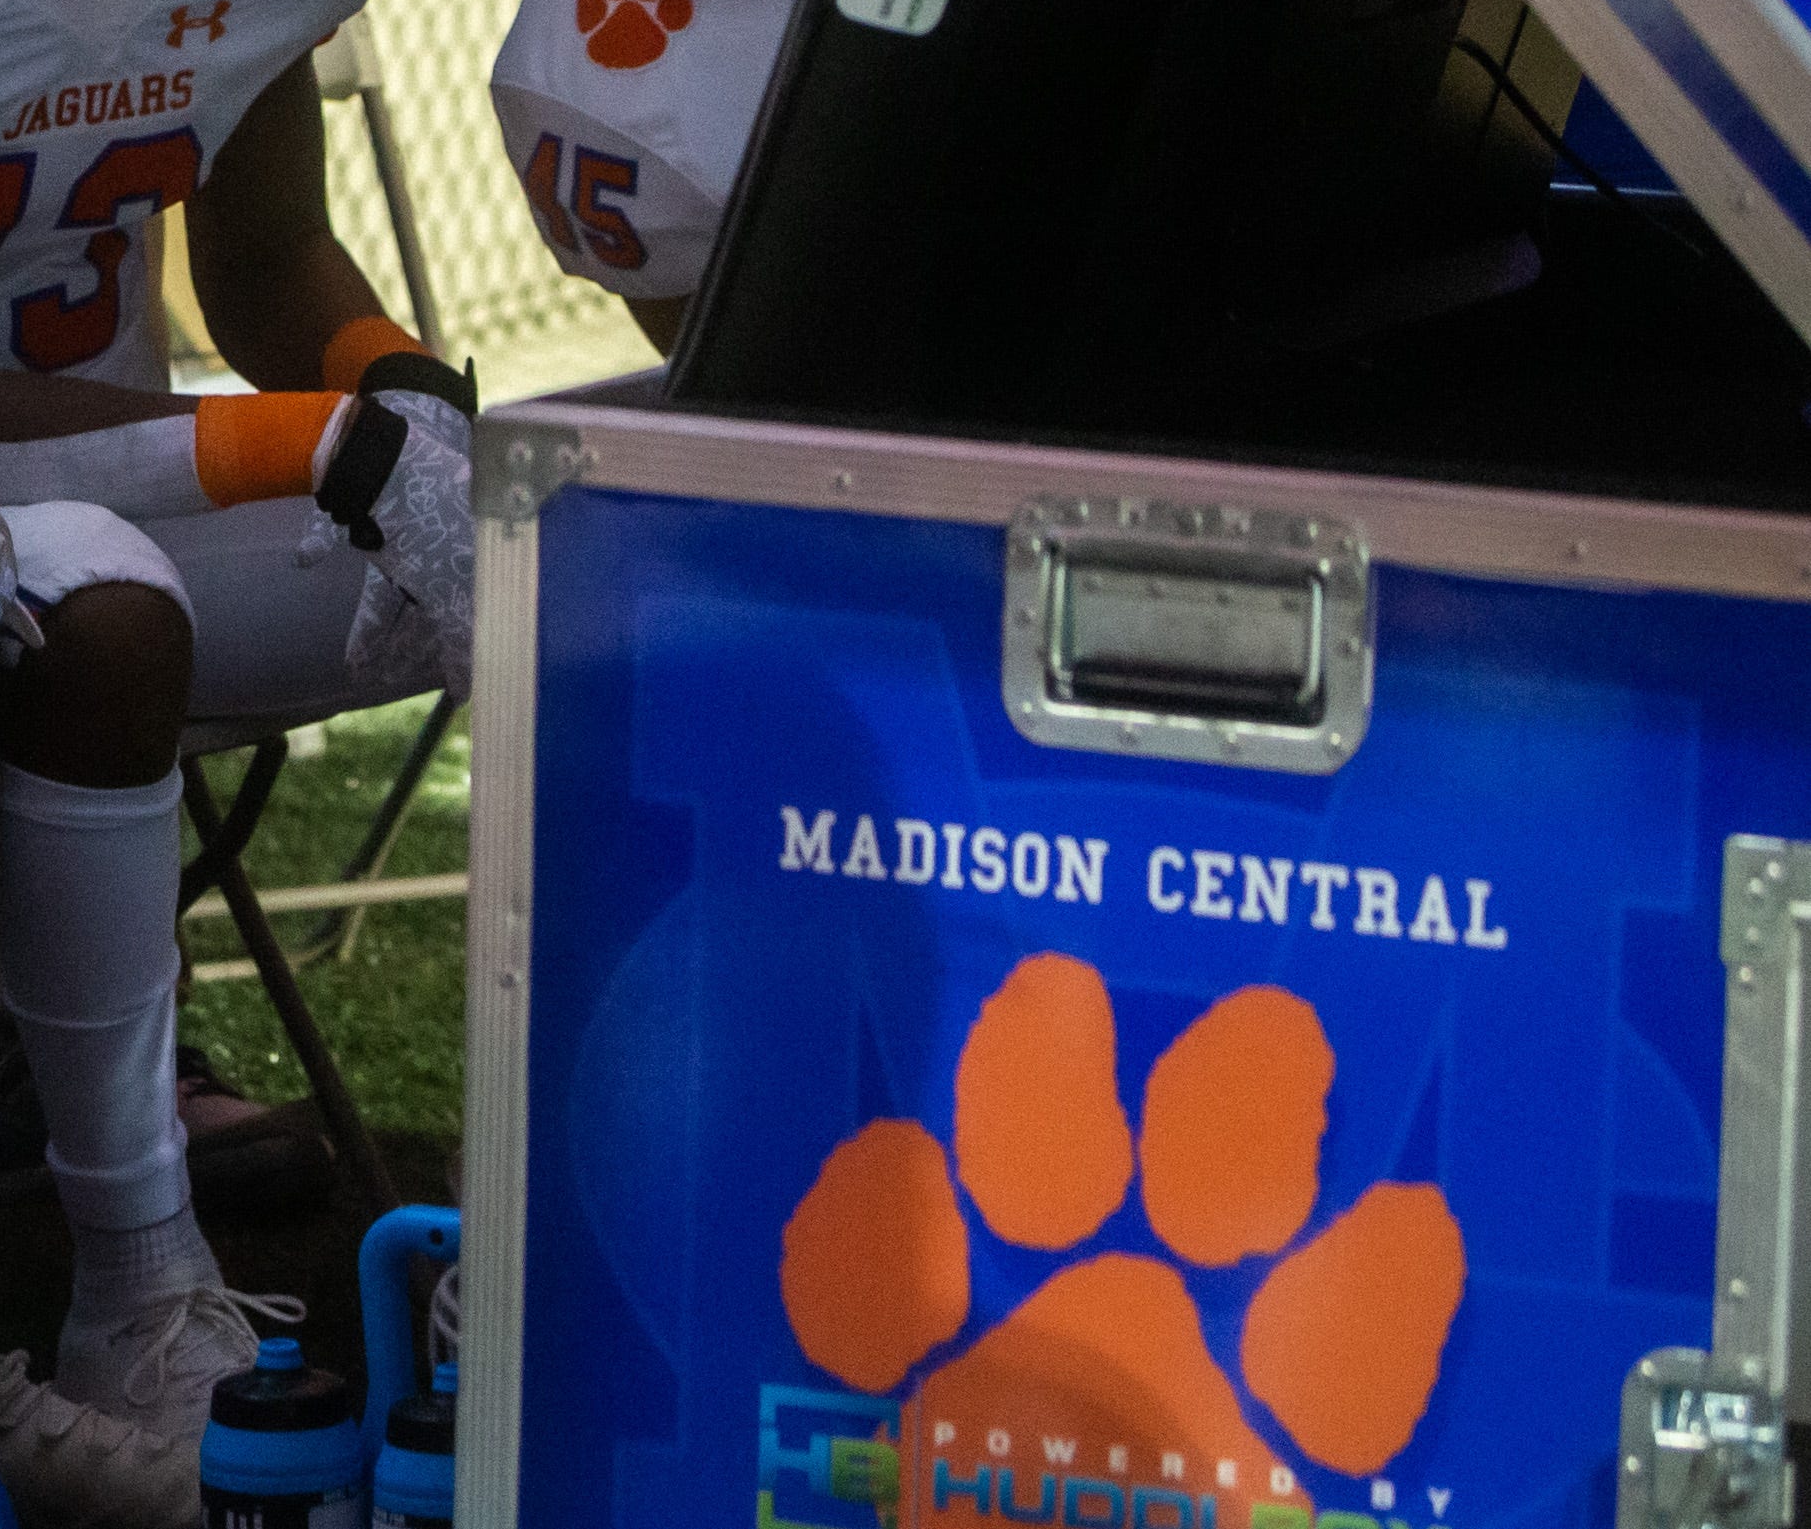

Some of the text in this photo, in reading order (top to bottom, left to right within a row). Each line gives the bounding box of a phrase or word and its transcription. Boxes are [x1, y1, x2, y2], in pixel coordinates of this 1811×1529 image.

[3, 69, 195, 140] JAGUARS
[524, 132, 649, 271] 15
[779, 805, 1508, 950] MADISON CENTRAL
[934, 1421, 1452, 1519] POWERED BY
